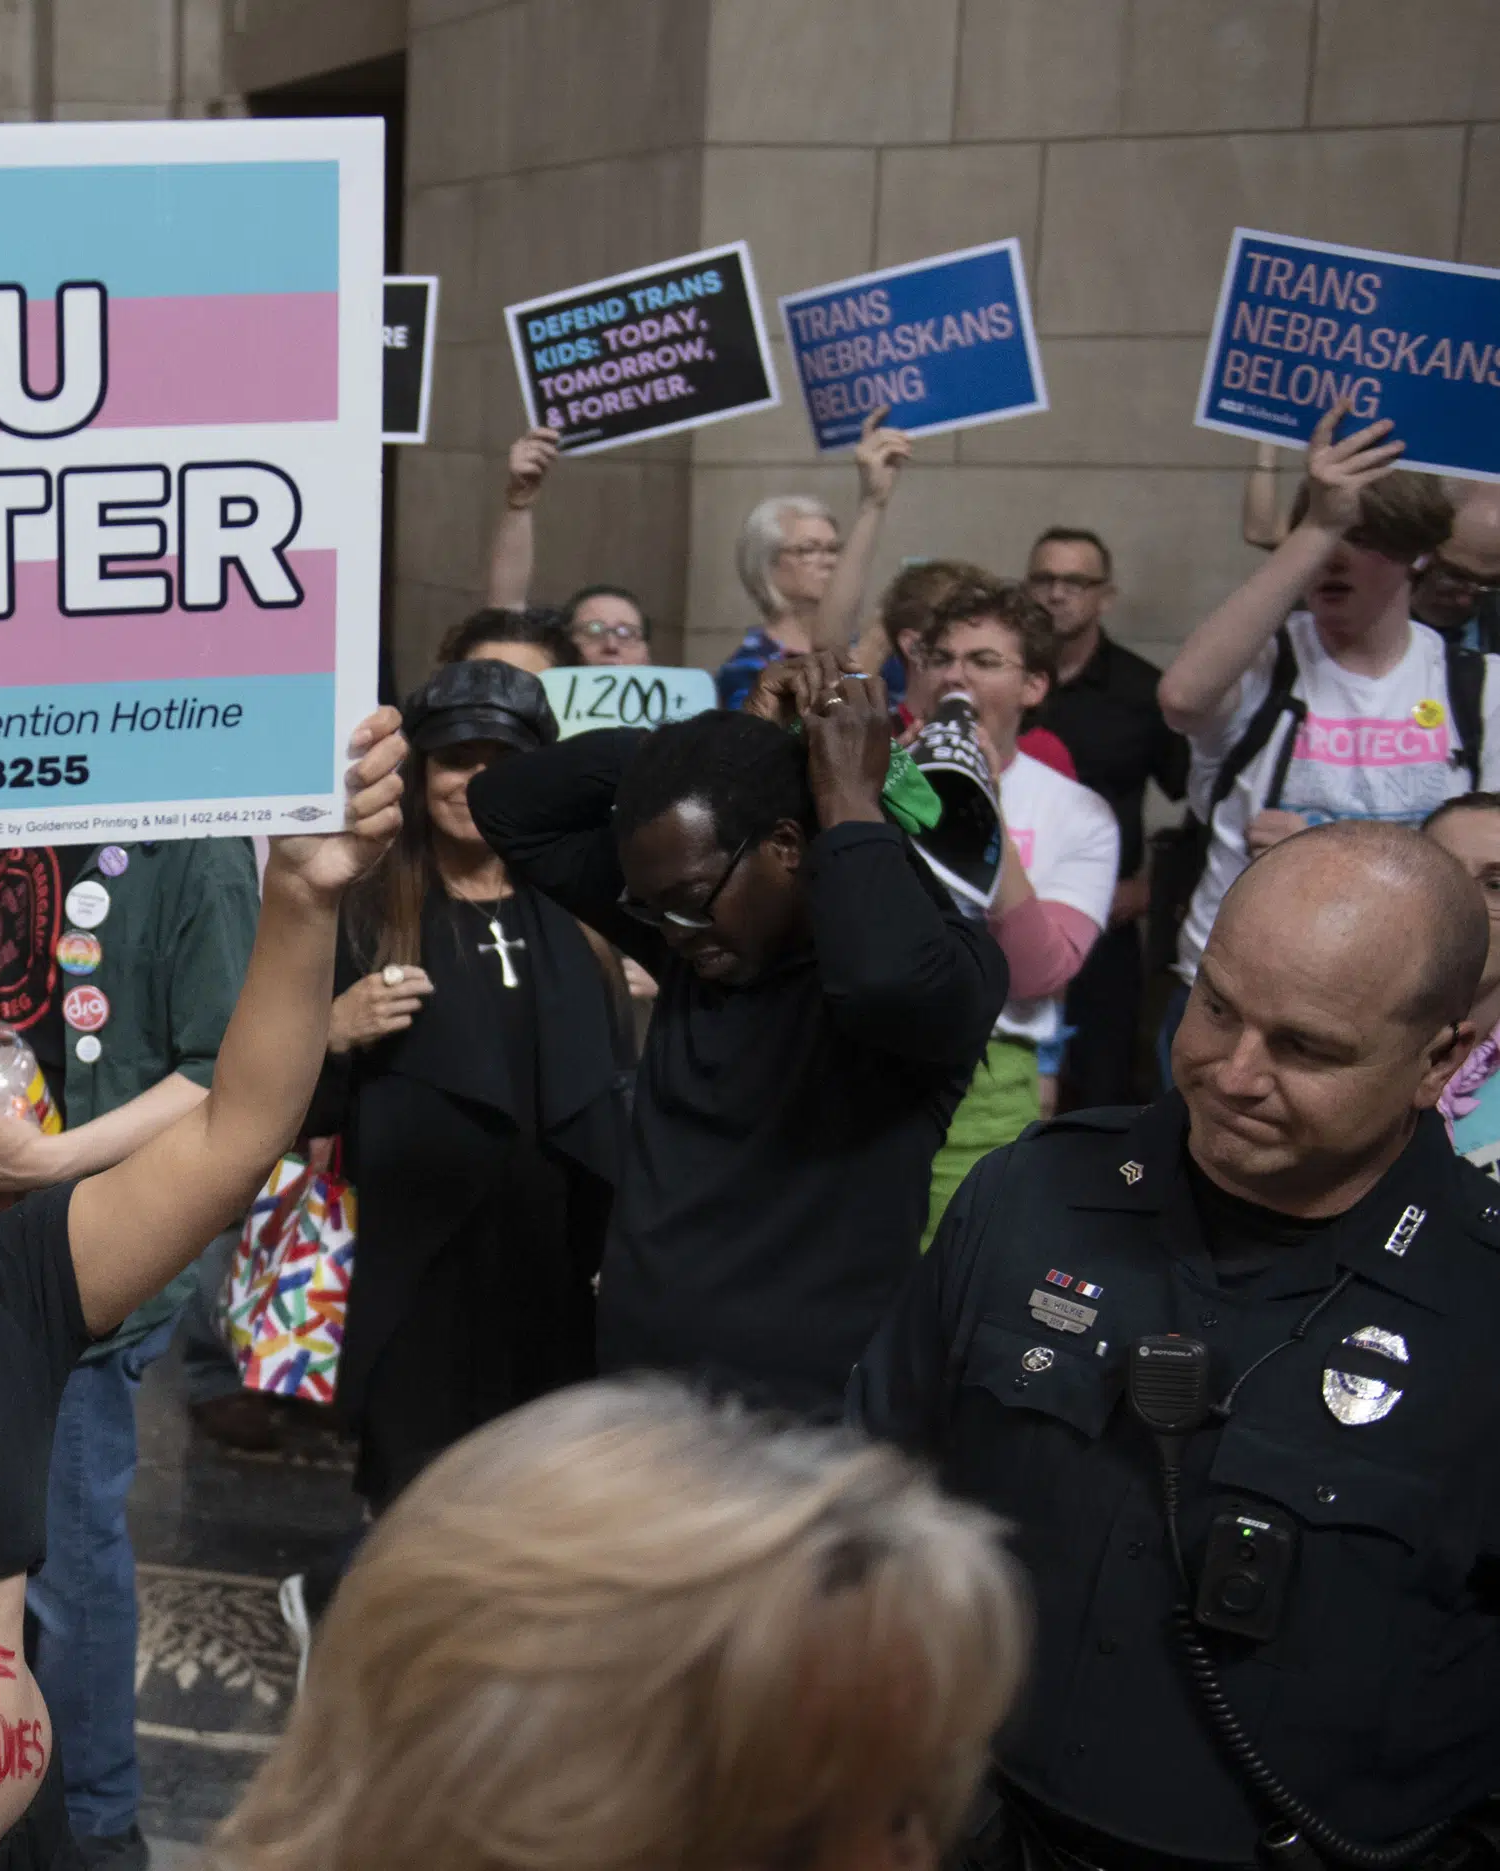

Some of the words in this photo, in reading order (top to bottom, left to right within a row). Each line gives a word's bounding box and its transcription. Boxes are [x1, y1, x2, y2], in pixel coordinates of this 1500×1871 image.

[527, 297, 627, 344] DEFEND
[629, 269, 724, 314] TRANS
[1247, 252, 1382, 315] TRANS
[532, 336, 600, 373] KIDS:
[601, 307, 709, 351] TODAY,
[791, 289, 892, 343] TRANS
[802, 302, 1015, 382] NEBRASKANS
[537, 338, 716, 400] TOMORROW,
[810, 365, 927, 422] BELONG
[1222, 349, 1381, 419] BELONG
[544, 406, 566, 428] &
[568, 374, 696, 424] FOREVER.
[110, 697, 243, 733] Hotline
[8, 823, 21, 835] by
[26, 819, 89, 832] Goldenrod
[93, 816, 137, 829] Printing
[142, 816, 150, 826] &
[155, 814, 178, 825] Mail
